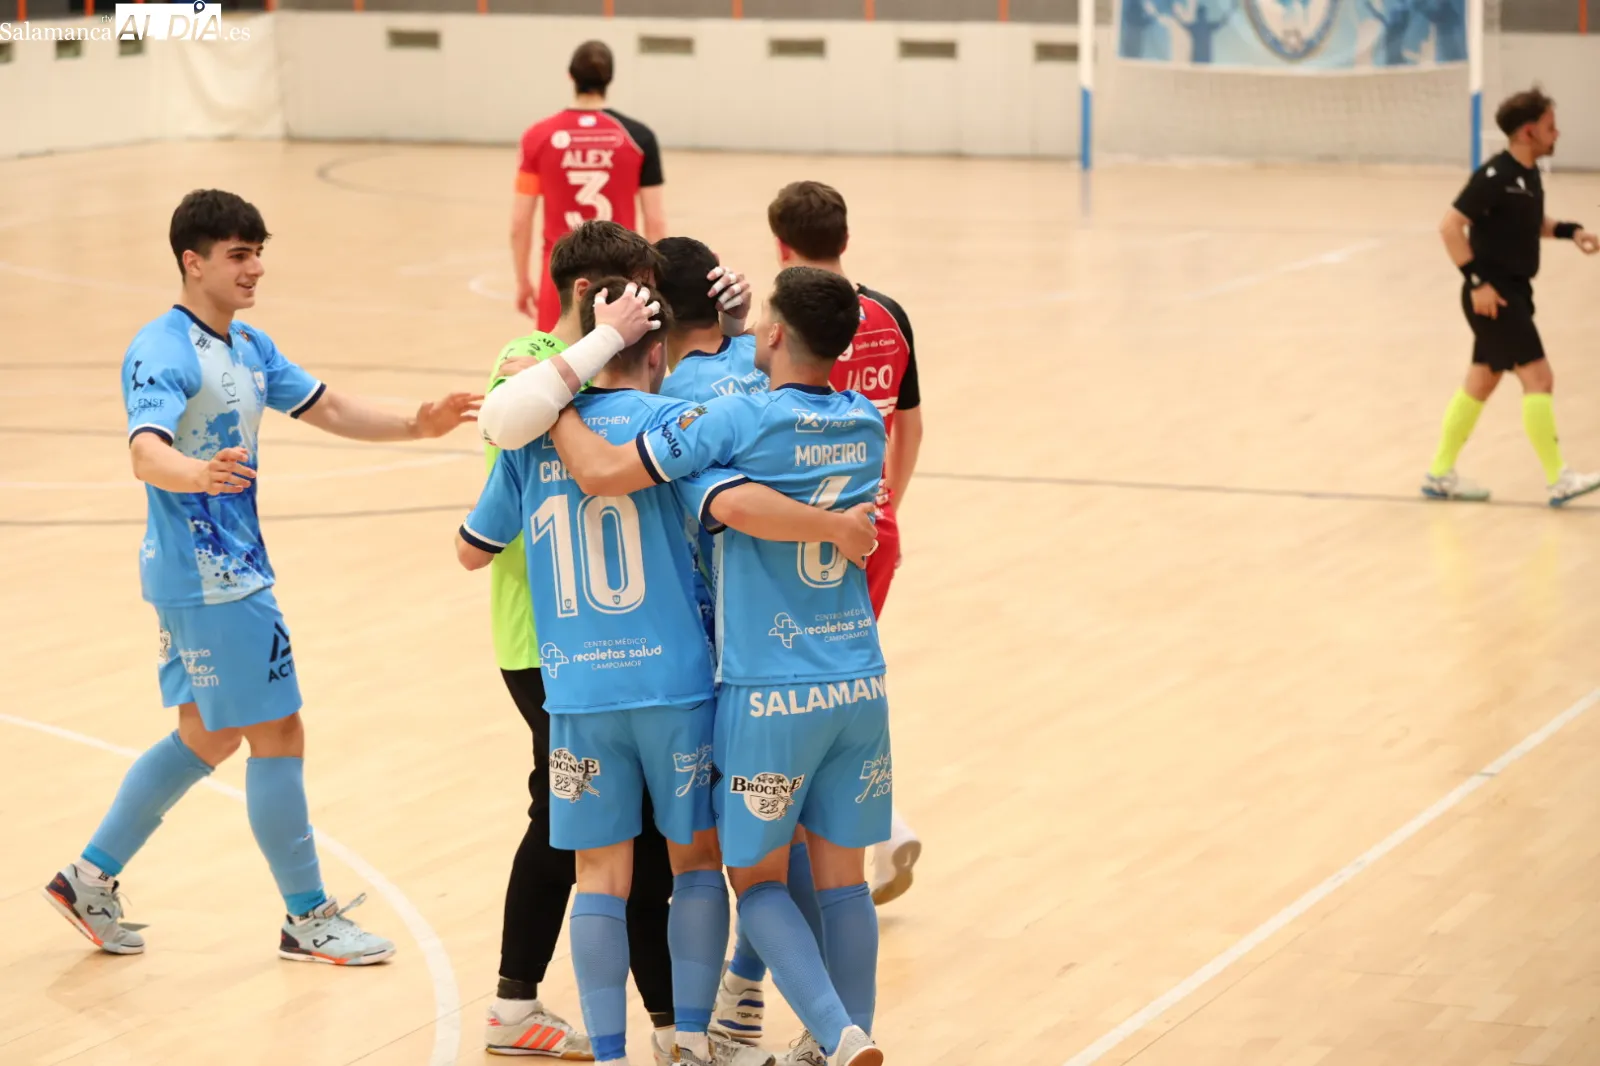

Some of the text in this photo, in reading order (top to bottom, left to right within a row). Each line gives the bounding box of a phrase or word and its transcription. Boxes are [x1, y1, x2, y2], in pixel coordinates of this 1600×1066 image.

[561, 149, 615, 168] ALEX
[564, 170, 613, 231] 3
[795, 442, 867, 467] MOREIRO
[796, 475, 852, 589] 6
[530, 493, 645, 618] 10
[804, 621, 855, 635] recoletas
[583, 637, 647, 649] CENTRO MÉDICO
[572, 644, 662, 662] recoletas salud
[591, 660, 642, 670] CAMPOAMOR
[554, 774, 571, 793] 22
[758, 798, 779, 814] 22
